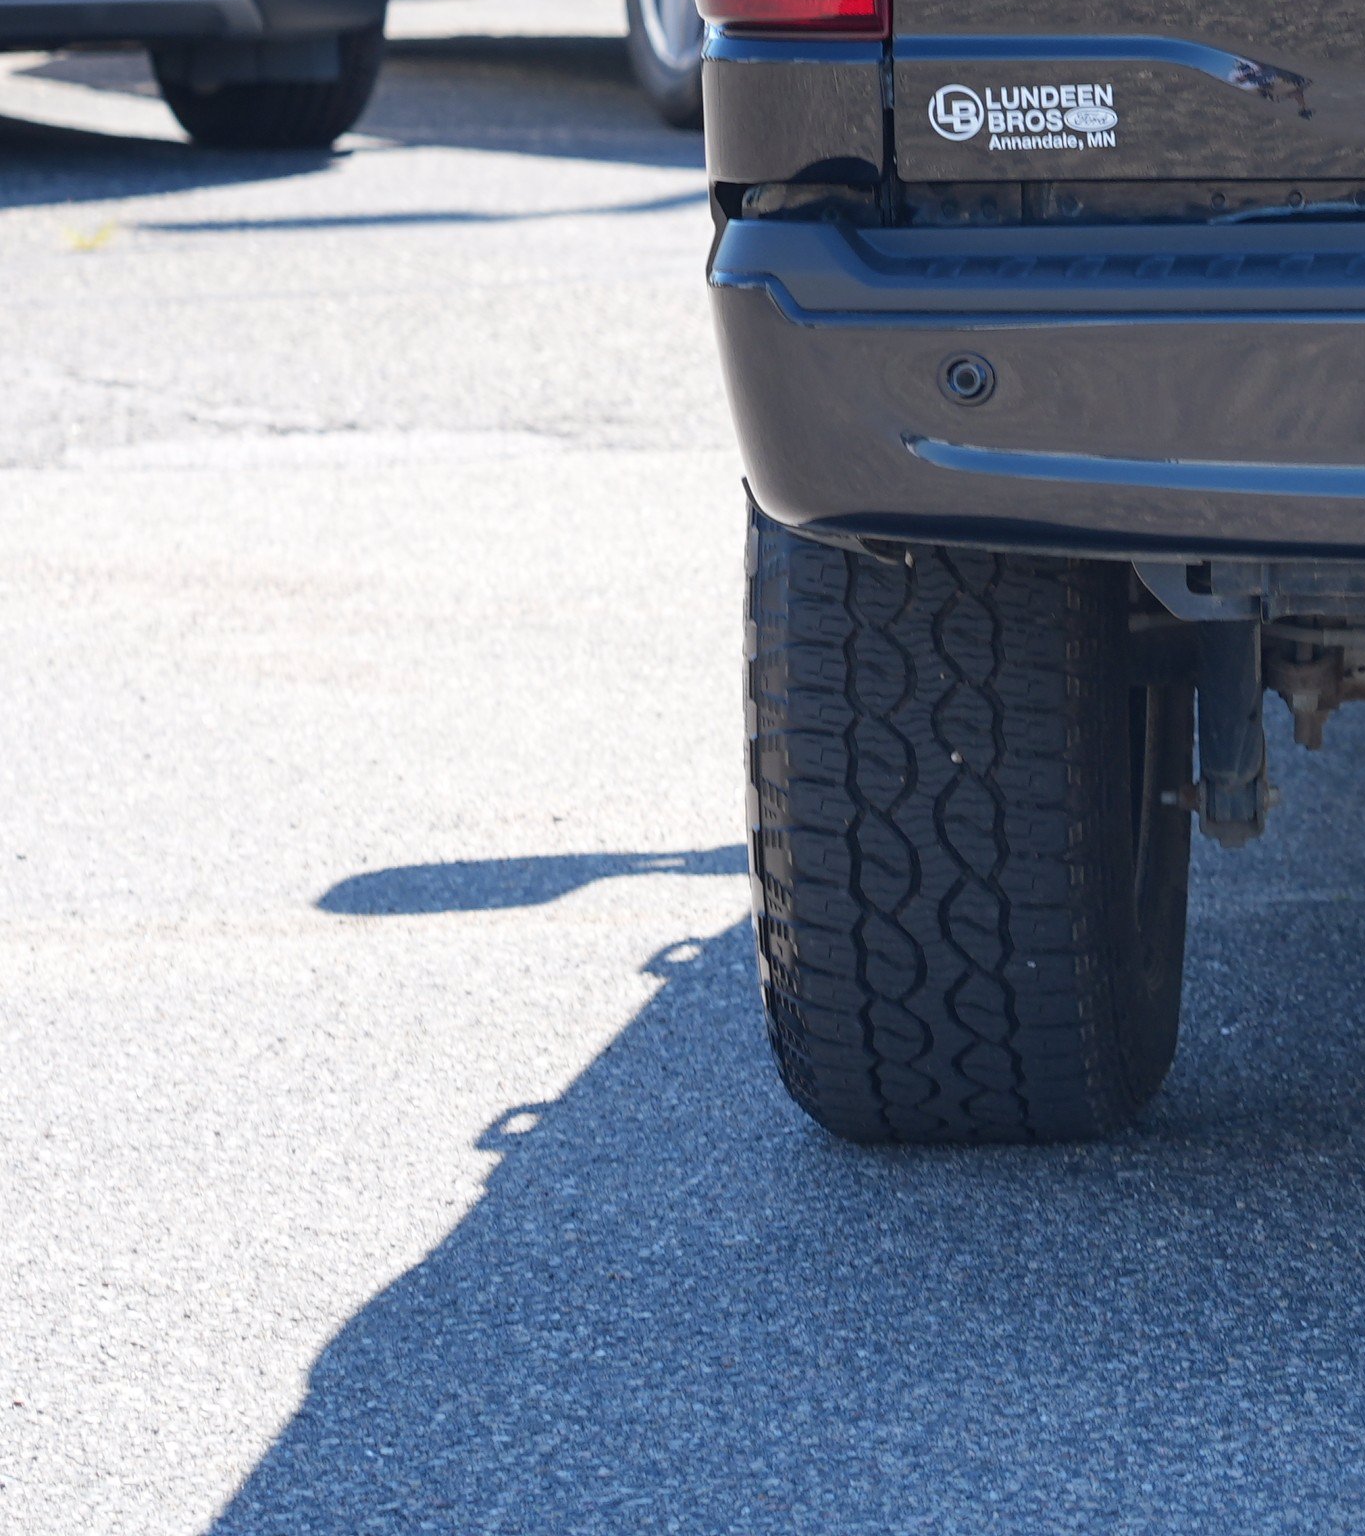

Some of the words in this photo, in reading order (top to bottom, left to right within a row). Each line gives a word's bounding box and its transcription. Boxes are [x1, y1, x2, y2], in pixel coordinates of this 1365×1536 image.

[985, 84, 1114, 110] LUNDEEN
[988, 108, 1064, 133] BROS
[989, 132, 1084, 151] Annandale,
[1087, 131, 1116, 148] MN
